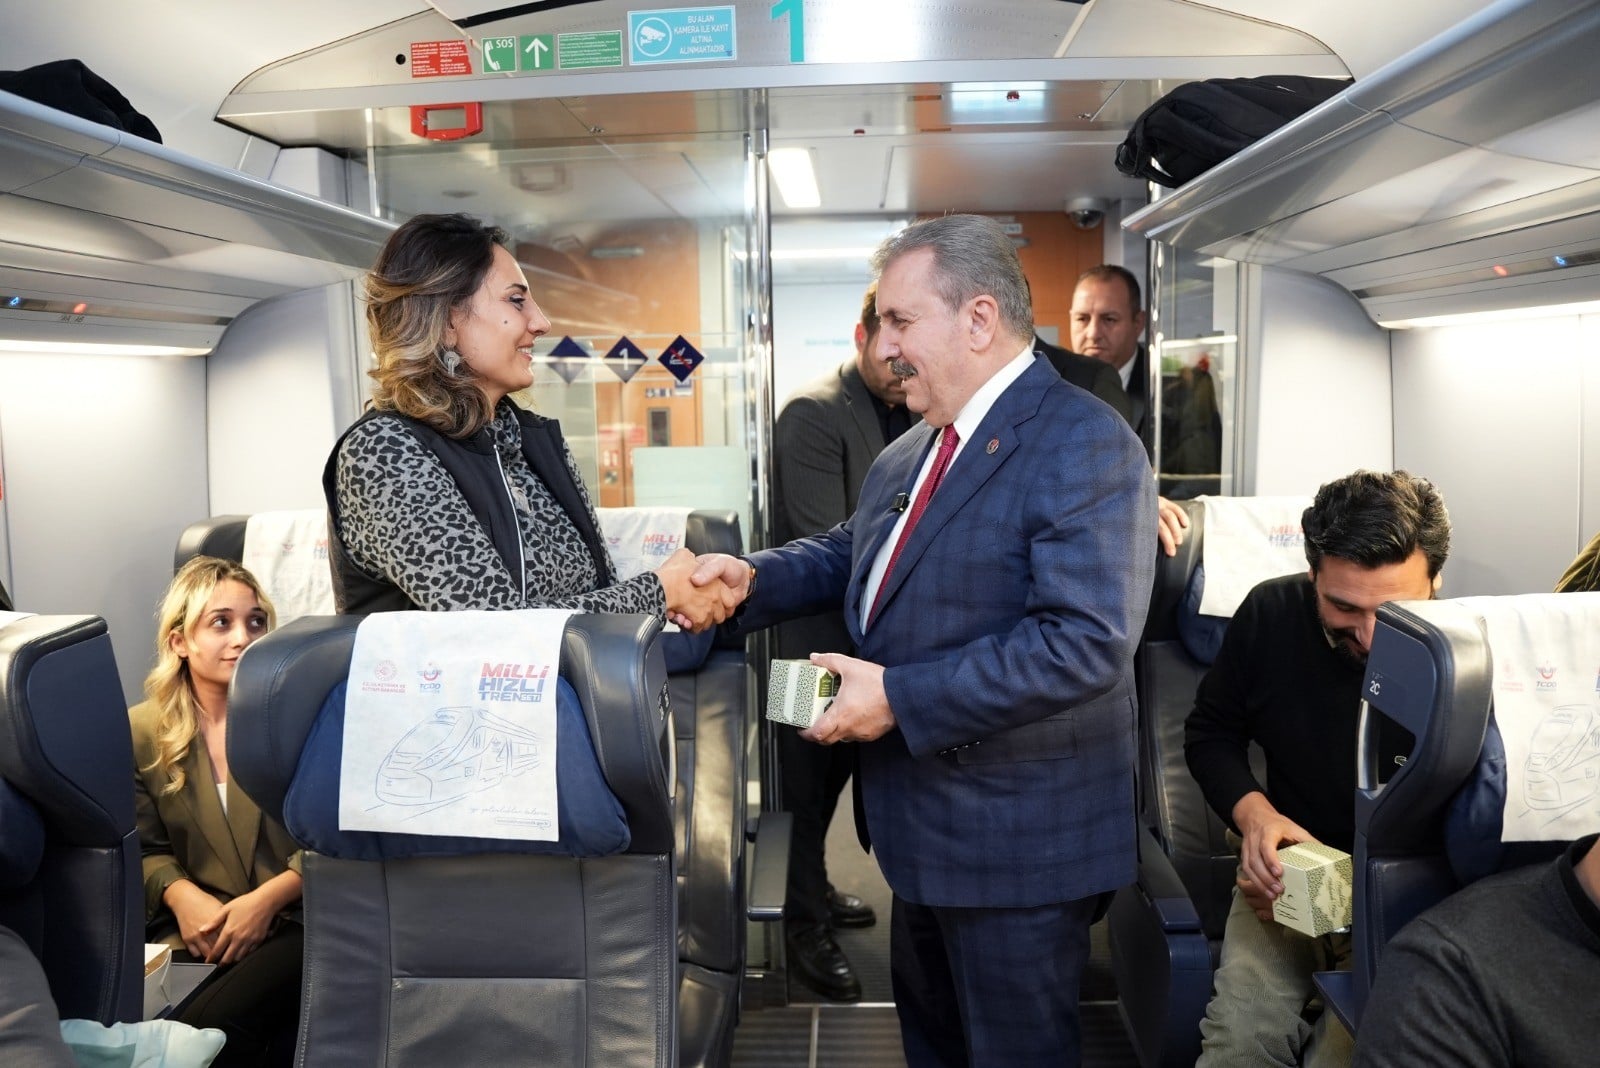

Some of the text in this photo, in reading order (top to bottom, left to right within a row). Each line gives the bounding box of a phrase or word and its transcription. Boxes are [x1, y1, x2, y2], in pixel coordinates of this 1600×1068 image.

[687, 14, 715, 24] BU ALAN
[673, 25, 700, 35] KAMERA
[771, 0, 805, 63] 1
[495, 38, 514, 49] SOS
[690, 35, 713, 44] ALTINA
[619, 347, 629, 371] 1
[478, 677, 546, 693] HIZLI
[1369, 679, 1381, 696] 2C
